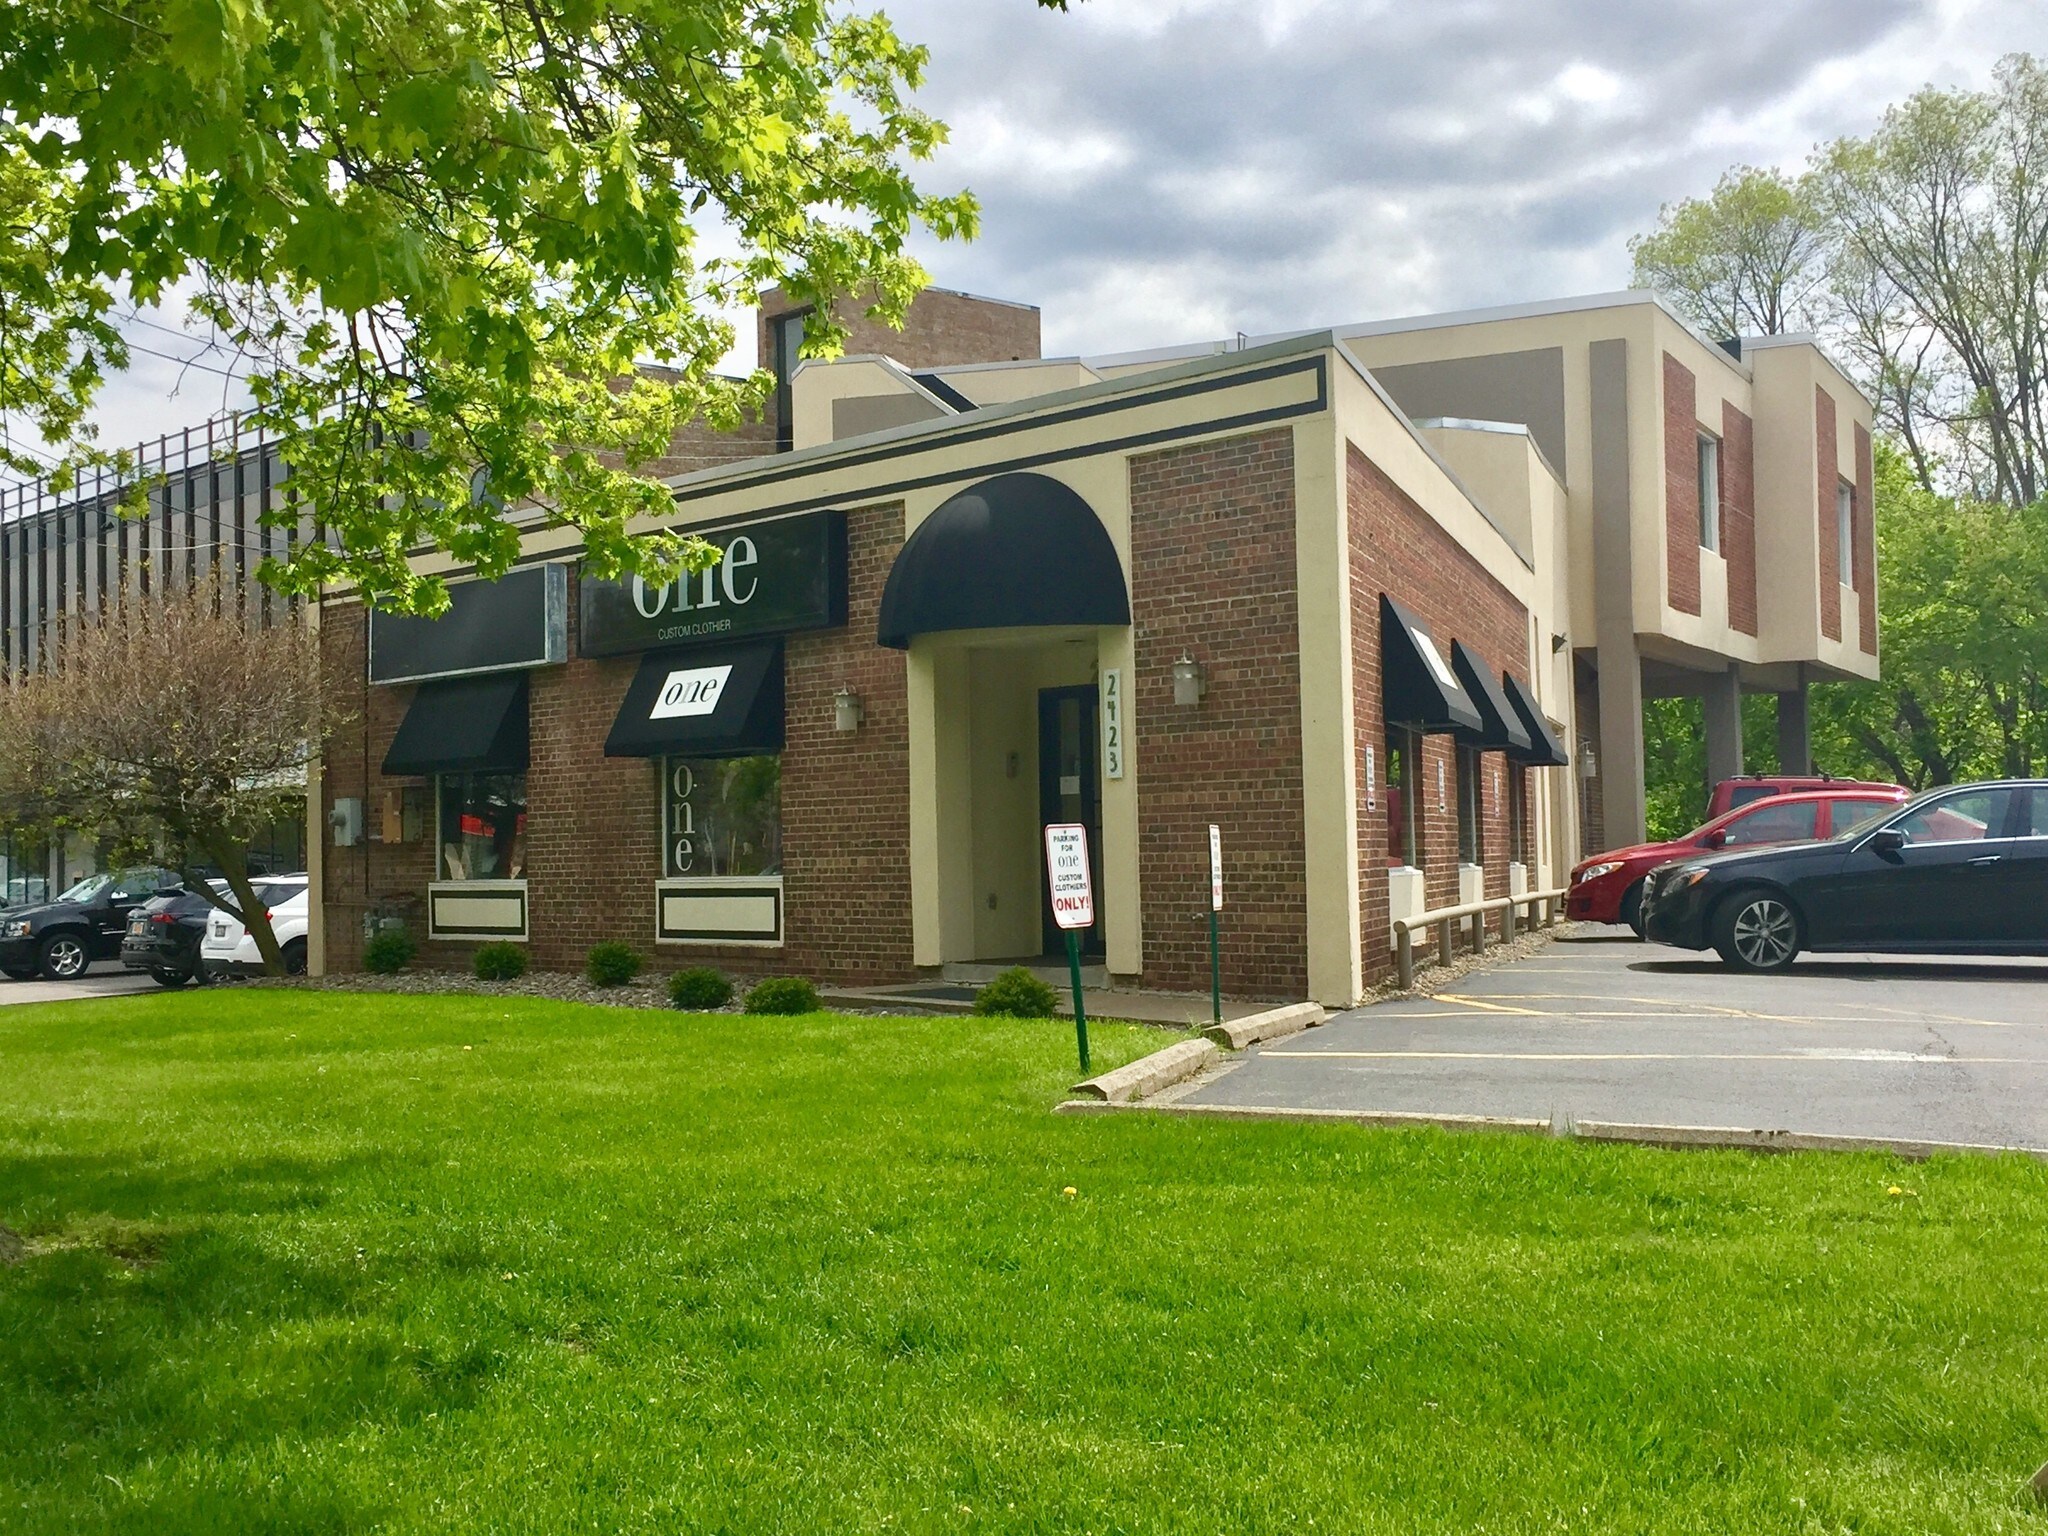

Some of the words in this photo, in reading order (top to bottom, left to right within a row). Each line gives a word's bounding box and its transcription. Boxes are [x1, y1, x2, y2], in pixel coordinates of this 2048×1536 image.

[658, 624, 691, 640] CUSTOM
[691, 619, 731, 636] CLOTHIER
[664, 678, 718, 706] one
[1107, 674, 1118, 773] 2423
[672, 765, 696, 872] one
[1053, 834, 1079, 842] PARKING
[1061, 844, 1073, 852] FOR
[1058, 855, 1079, 868] one
[1058, 873, 1082, 882] CUSTOM
[1055, 882, 1087, 891] CLOTHIERS
[1056, 896, 1090, 911] ONLY!
